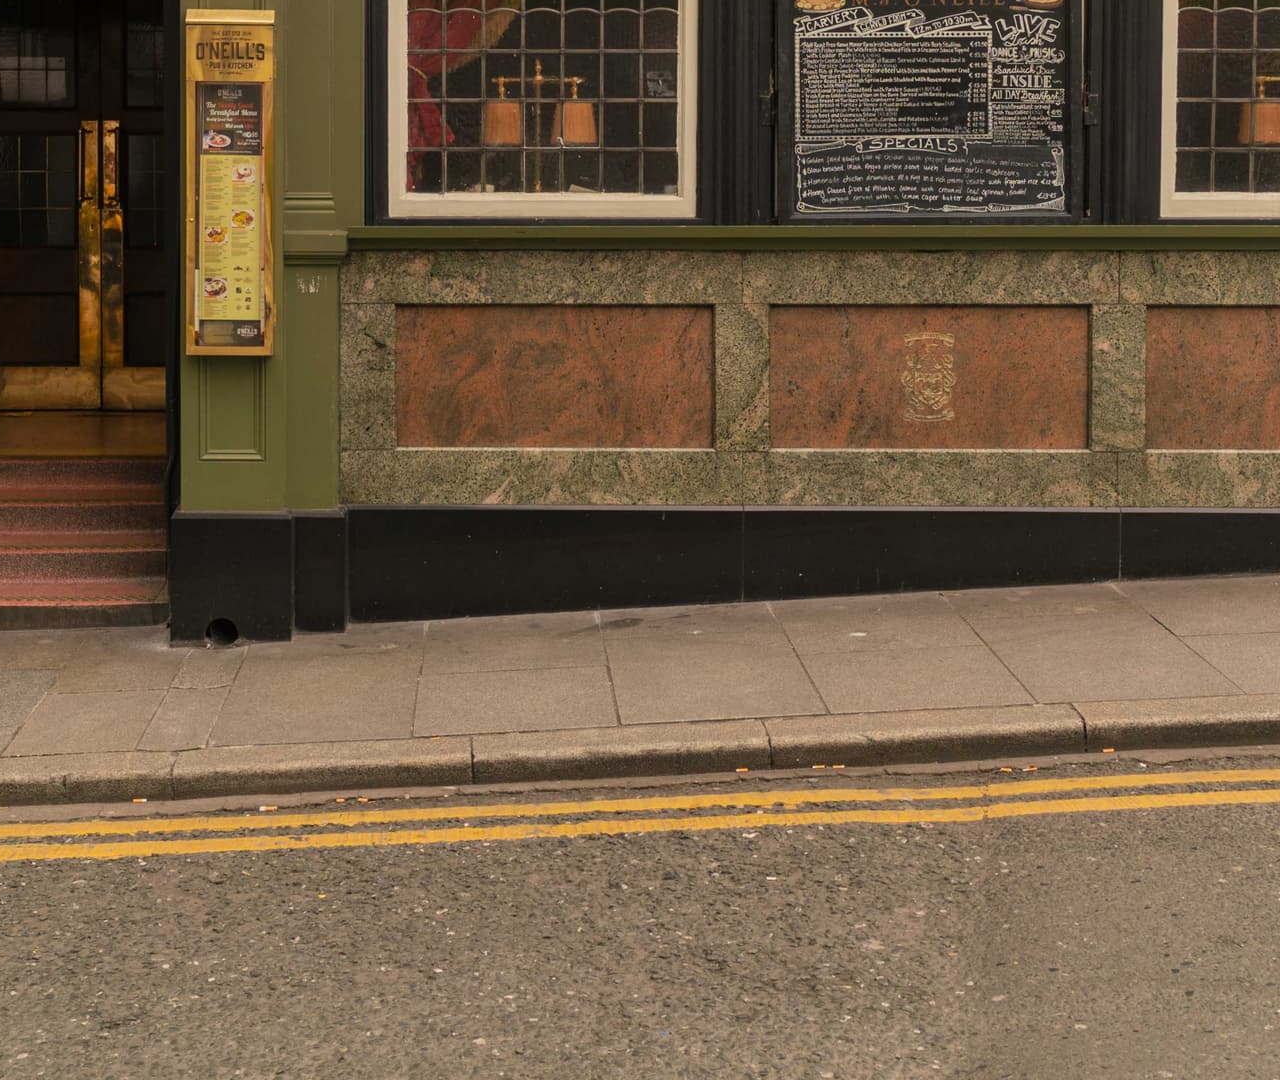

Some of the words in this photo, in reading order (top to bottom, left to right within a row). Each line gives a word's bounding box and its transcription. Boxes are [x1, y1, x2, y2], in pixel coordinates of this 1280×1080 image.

[807, 11, 859, 32] CARVERY
[995, 14, 1061, 43] LIVE
[196, 41, 265, 61] O'NEILL'S
[992, 47, 1018, 58] DANCE
[1029, 47, 1058, 58] MUSIC
[1001, 75, 1052, 88] INSIDE
[1005, 90, 1020, 100] DAY
[869, 138, 958, 152] SPECIALS
